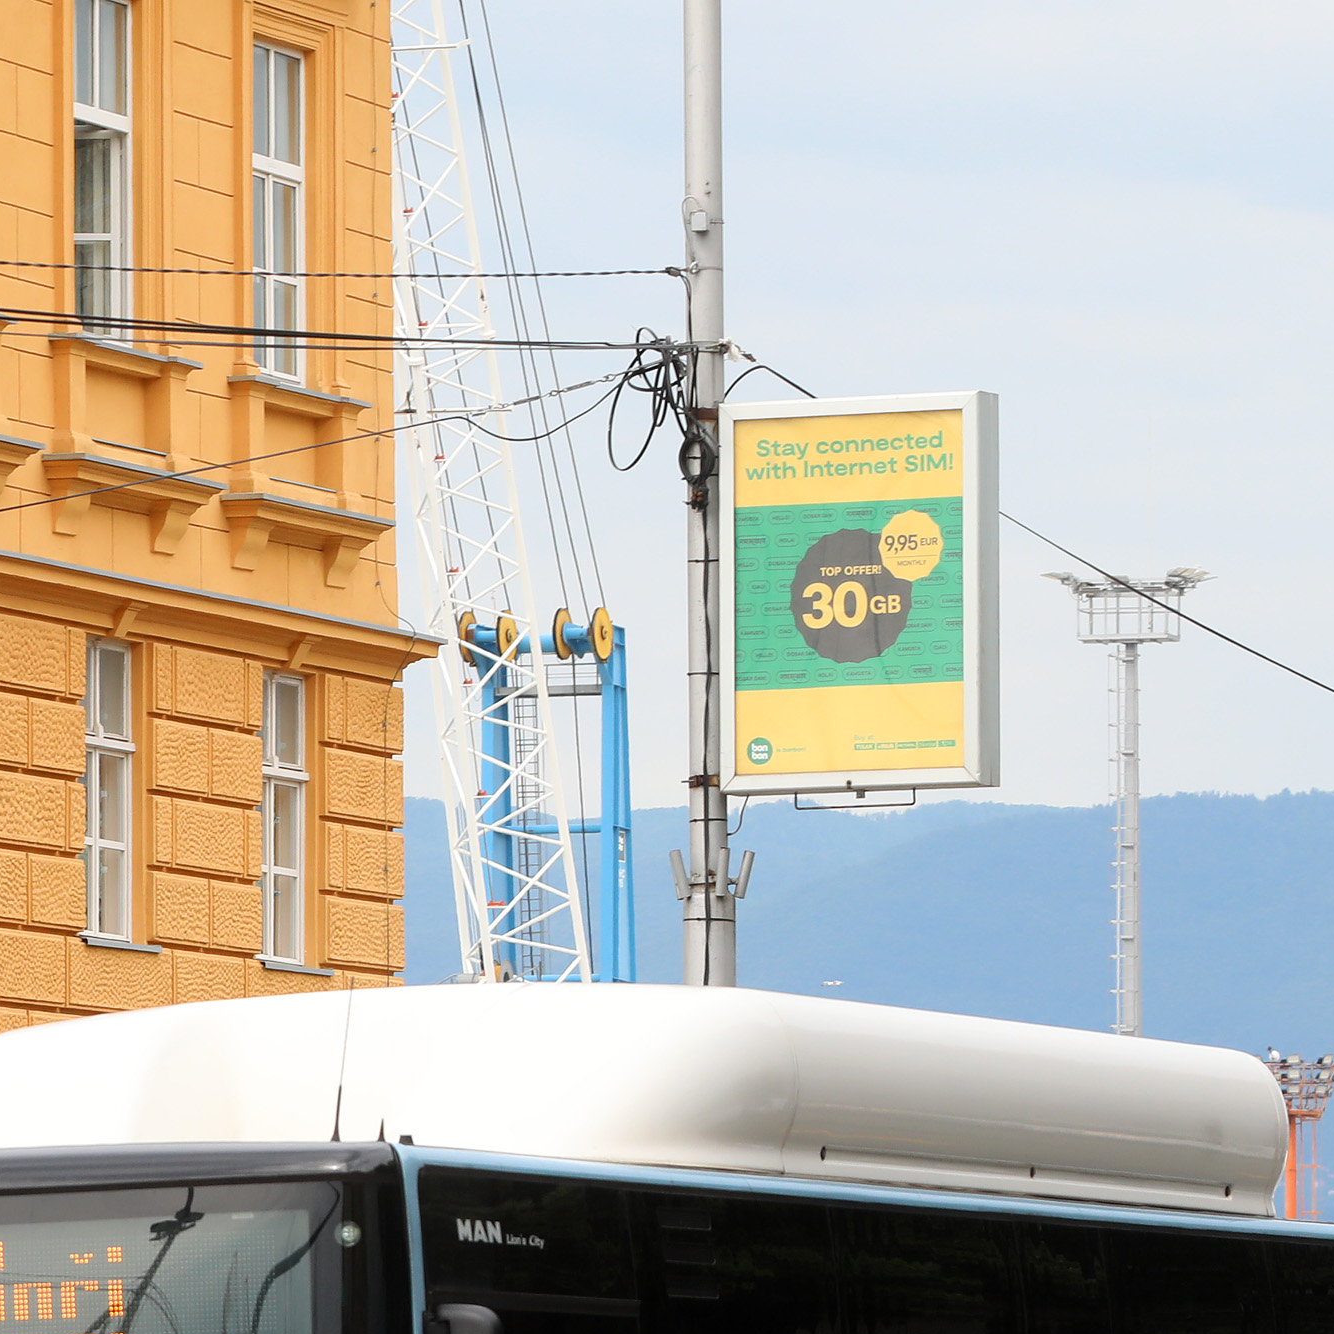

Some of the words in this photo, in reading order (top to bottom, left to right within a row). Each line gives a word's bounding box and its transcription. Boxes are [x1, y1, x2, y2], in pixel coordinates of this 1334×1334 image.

[756, 439, 809, 460] Stay
[816, 430, 943, 455] connected
[745, 461, 797, 481] with
[803, 457, 898, 478] Internet
[904, 452, 954, 472] SIM!
[884, 534, 918, 555] 9,95
[920, 537, 938, 546] EUR
[820, 566, 842, 577] TOP
[843, 564, 882, 576] OFFER!
[897, 559, 927, 567] MONTHLY
[751, 743, 769, 752] bon
[751, 751, 769, 760] bon
[456, 1218, 503, 1244] MAN
[506, 1233, 527, 1246] Lion's
[528, 1234, 545, 1250] City
